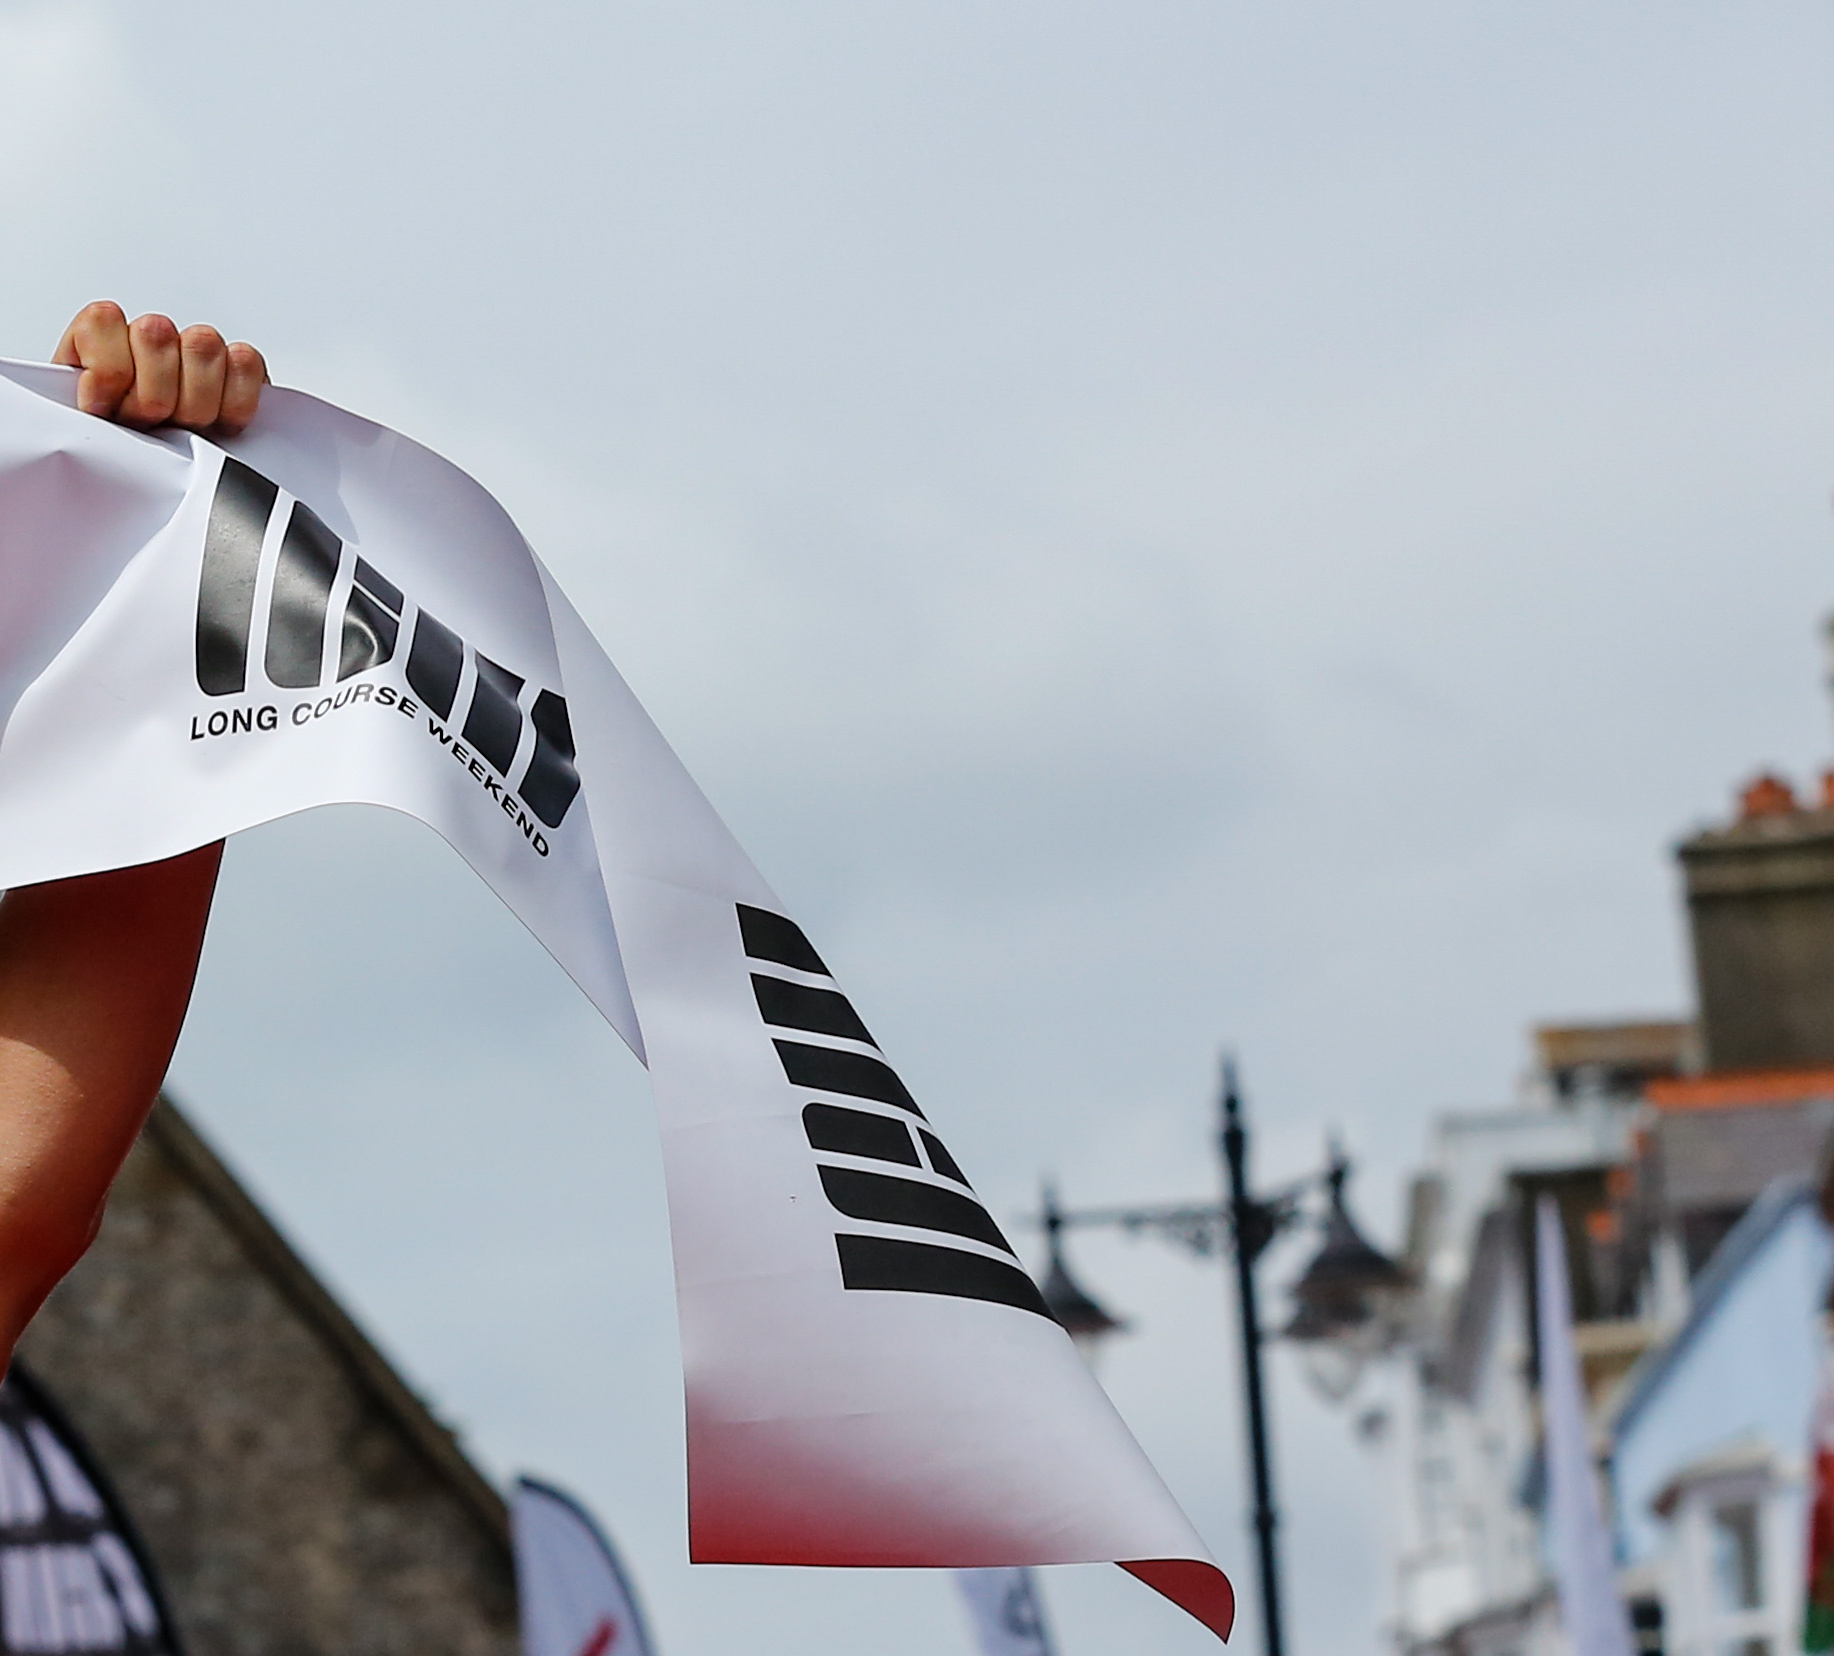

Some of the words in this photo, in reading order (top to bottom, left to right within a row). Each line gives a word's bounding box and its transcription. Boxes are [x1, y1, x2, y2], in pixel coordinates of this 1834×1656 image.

[190, 705, 279, 742] LONG
[290, 683, 420, 727] COURSE
[427, 716, 550, 858] WEEKEND
